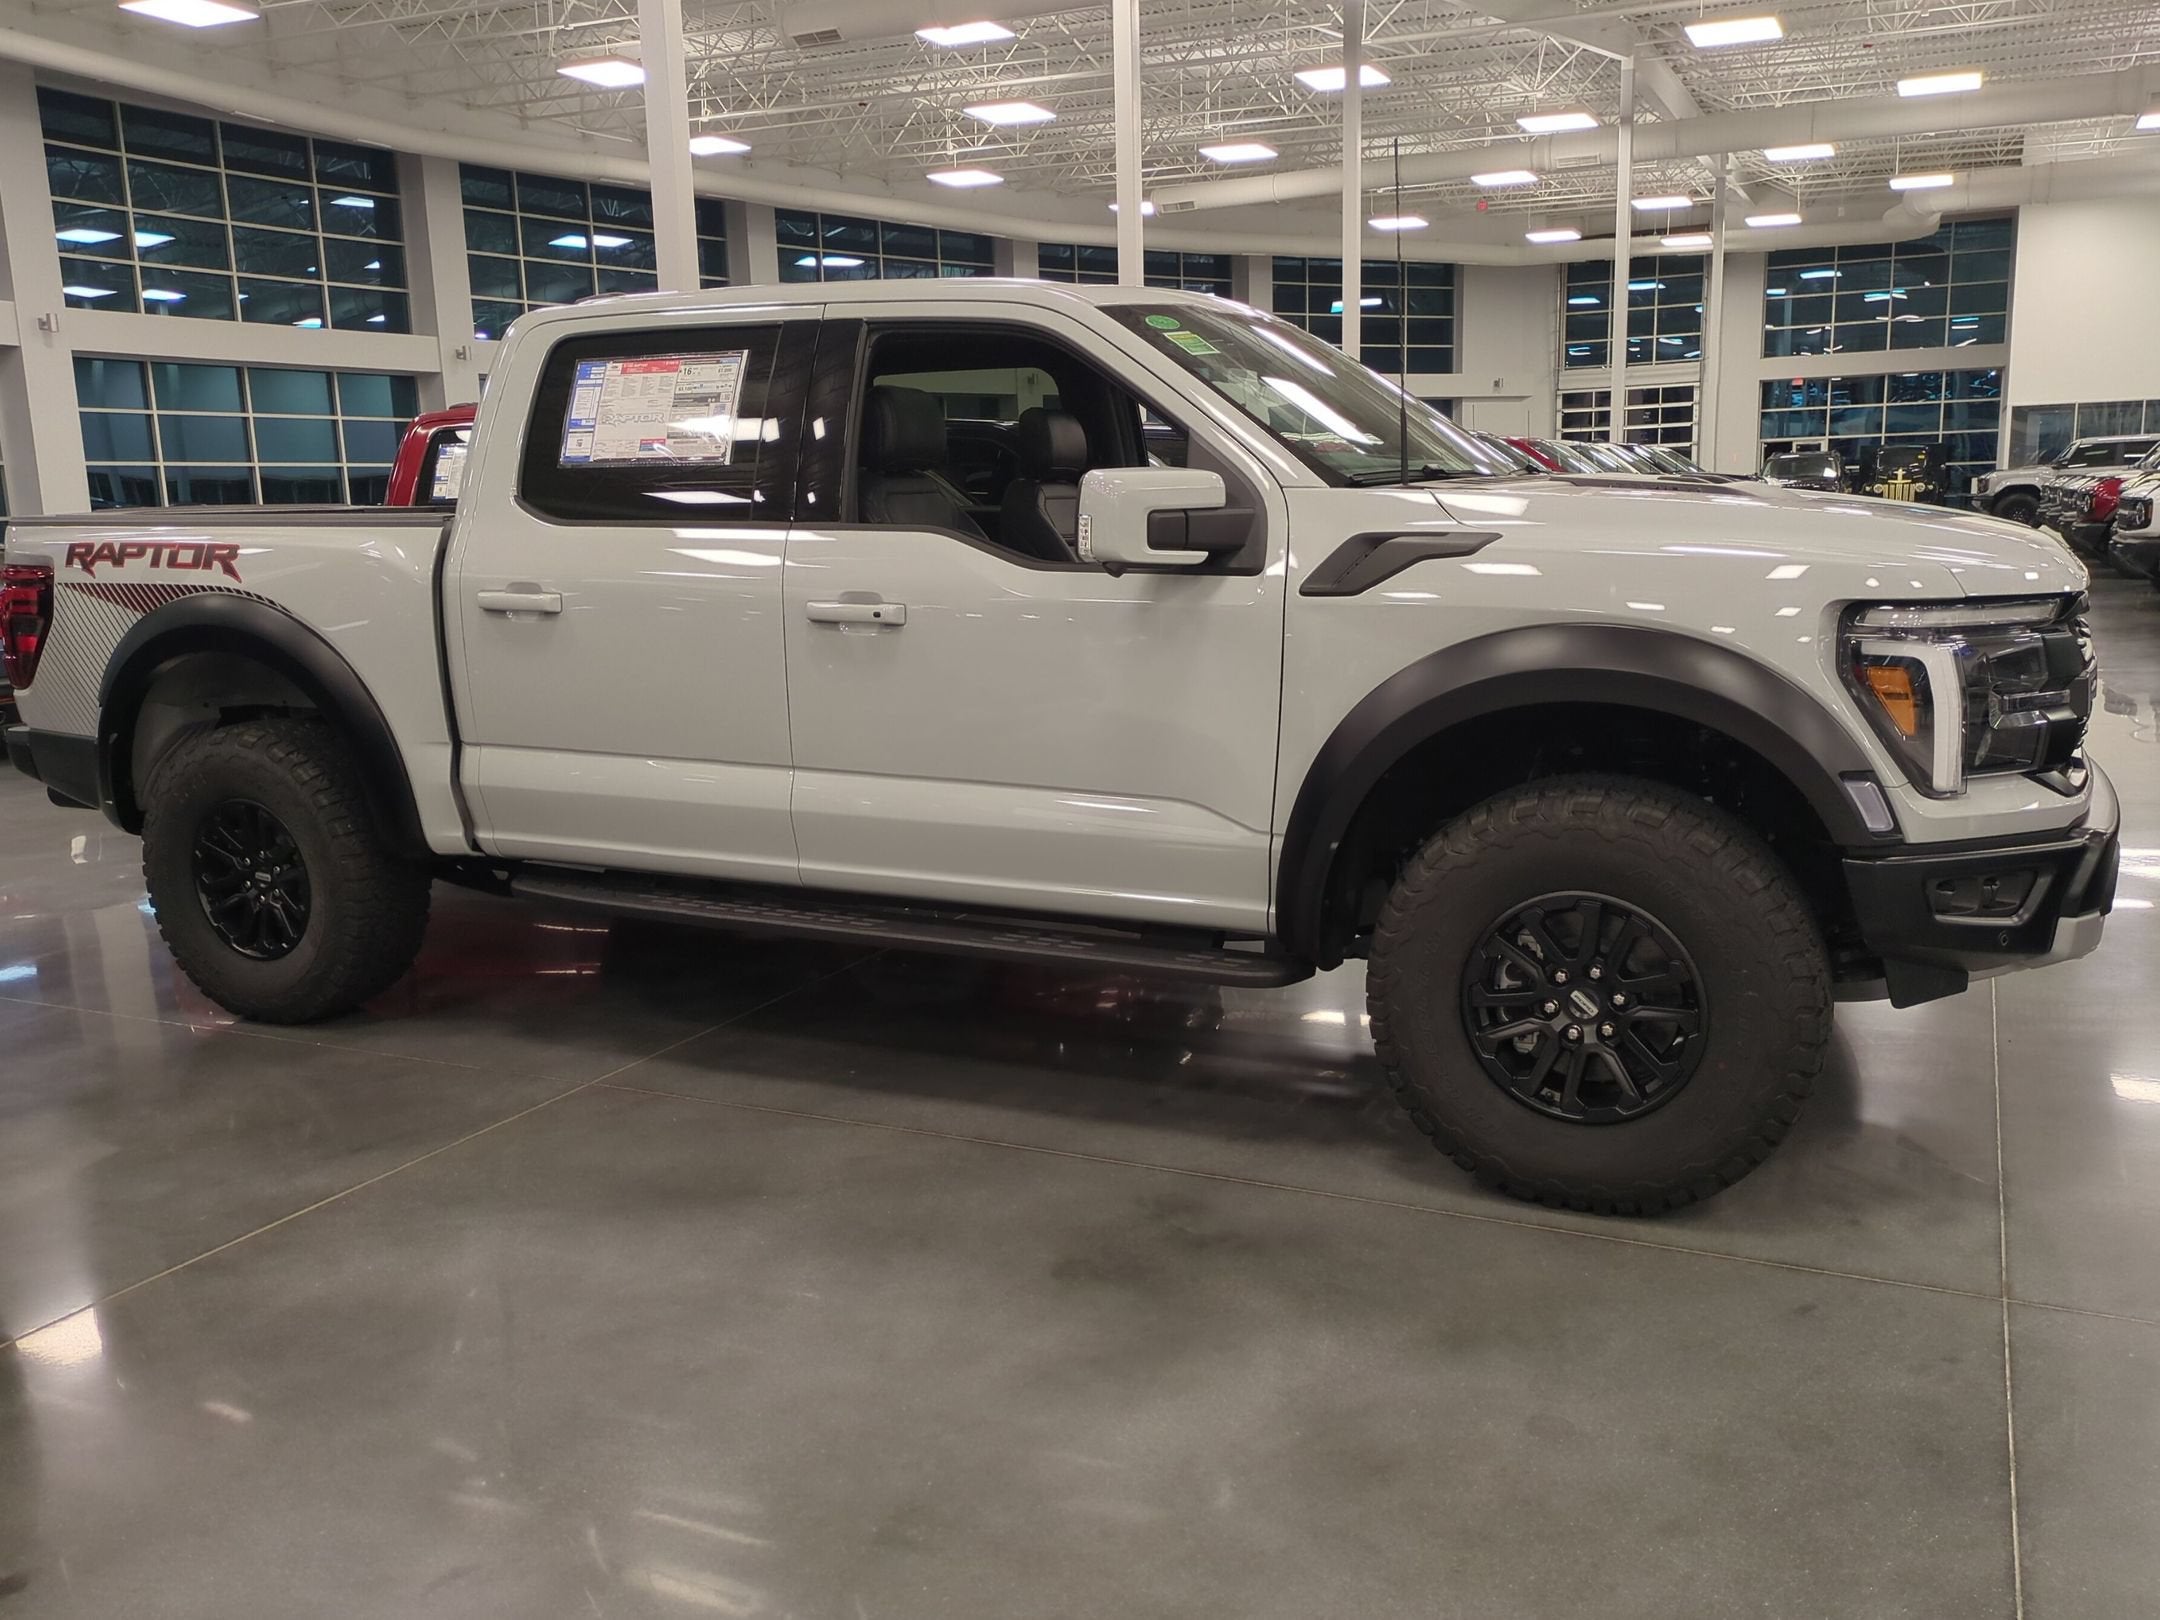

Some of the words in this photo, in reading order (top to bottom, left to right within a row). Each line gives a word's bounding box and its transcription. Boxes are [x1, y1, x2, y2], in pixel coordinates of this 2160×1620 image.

[683, 367, 692, 376] 16
[601, 412, 665, 427] RAPTOR
[64, 542, 242, 583] RAPTOR
